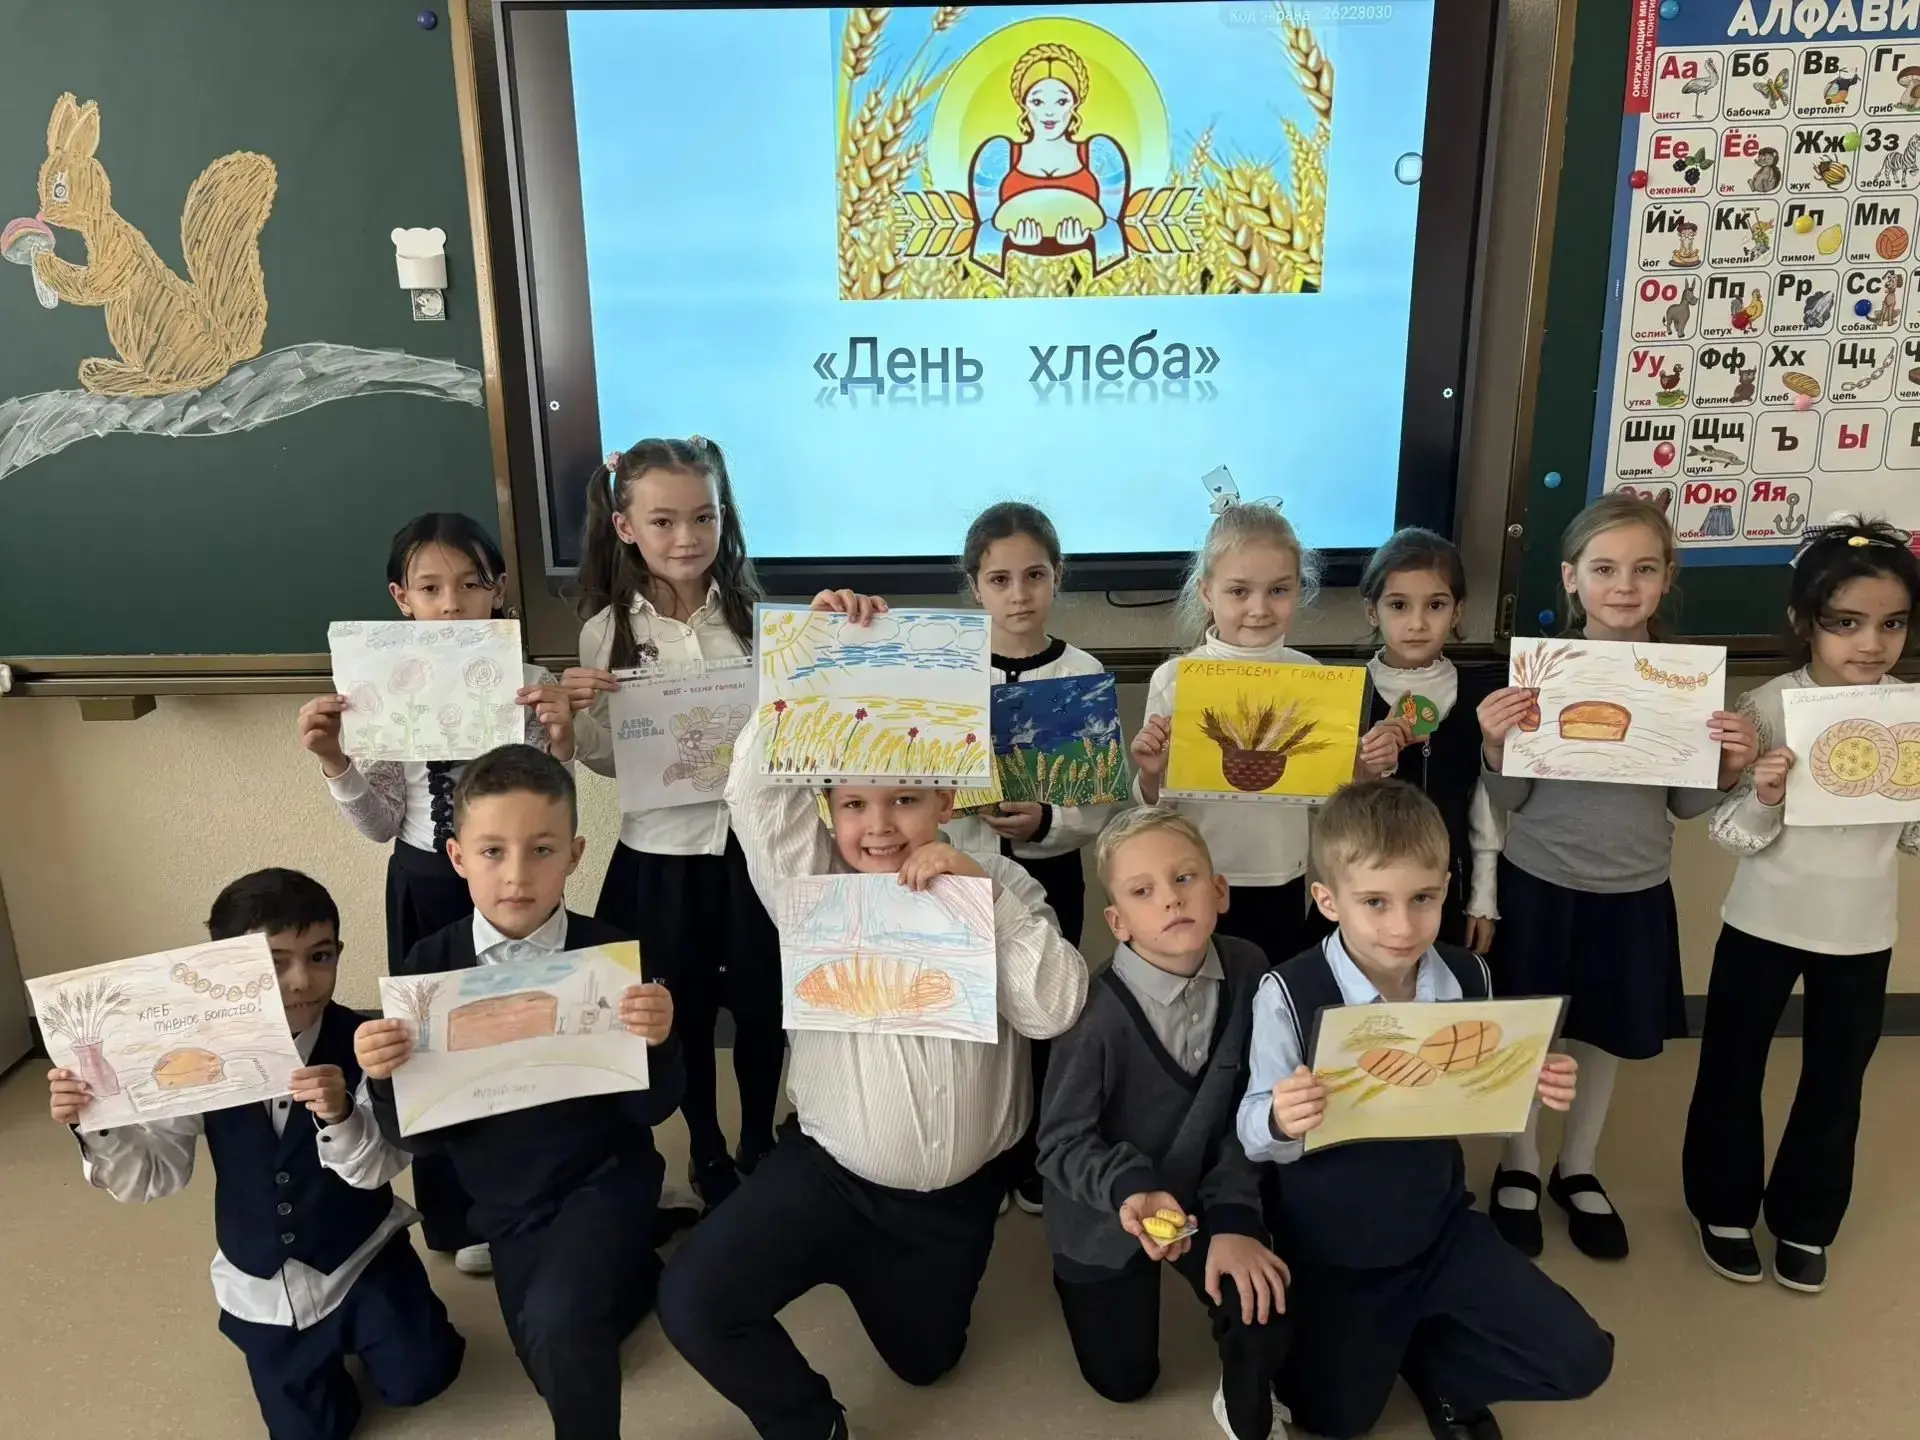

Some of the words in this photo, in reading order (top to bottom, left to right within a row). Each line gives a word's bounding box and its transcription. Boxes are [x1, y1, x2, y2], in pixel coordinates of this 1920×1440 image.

[1323, 5, 1392, 20] 26228030
[1632, 20, 1646, 97] ОКРУЖАЮЩИЙ
[1660, 56, 1698, 79] Аа
[1732, 52, 1769, 77] Бб
[1803, 51, 1840, 75] Вв
[1874, 48, 1906, 72] Гг
[1656, 111, 1681, 119] аист
[1726, 107, 1771, 117] бабочка
[1797, 105, 1846, 116] вертолёт
[1868, 103, 1893, 114] гриб
[1653, 136, 1689, 159] Ее
[1724, 129, 1759, 157] Ёё
[1794, 130, 1846, 154] Жж
[1864, 128, 1899, 152] Зз
[1649, 185, 1696, 195] ежевика
[1720, 184, 1735, 192] ёж
[1790, 182, 1811, 192] жук
[1860, 179, 1892, 189] зебра
[1645, 204, 1685, 233] Йй
[1715, 207, 1750, 230] Кк
[1855, 203, 1900, 226] Мм
[1642, 259, 1660, 268] йог
[1711, 255, 1749, 264] качели
[1781, 254, 1815, 262] лимон
[1850, 253, 1870, 261] мяч
[1640, 279, 1677, 302] Оо
[1707, 276, 1745, 299] Пп
[1778, 274, 1812, 301] Рр
[1847, 272, 1881, 294] Сс
[1635, 330, 1667, 338] ослик
[1703, 327, 1732, 336] петух
[1773, 323, 1809, 333] ракета
[1841, 322, 1877, 331] собака
[812, 336, 984, 395] «День
[1028, 328, 1221, 383] хлеба»
[1632, 350, 1665, 377] Уу
[1700, 347, 1745, 374] Фф
[1768, 345, 1806, 367] Хх
[1838, 342, 1876, 368] Цц
[1629, 398, 1651, 408] утка
[1696, 396, 1729, 405] филин
[1764, 393, 1789, 402] хлеб
[1625, 420, 1675, 442] Шш
[1692, 418, 1744, 443] Щщ
[1771, 426, 1799, 451] Ъ
[1838, 423, 1870, 449] Ы
[1620, 468, 1652, 477] шарик
[1687, 466, 1713, 474] щука
[1684, 483, 1737, 504] Юю
[1751, 481, 1787, 502] Яя
[1679, 529, 1706, 538] юбка
[1746, 528, 1776, 537] якорь
[138, 1003, 170, 1021] ХЛЕБ
